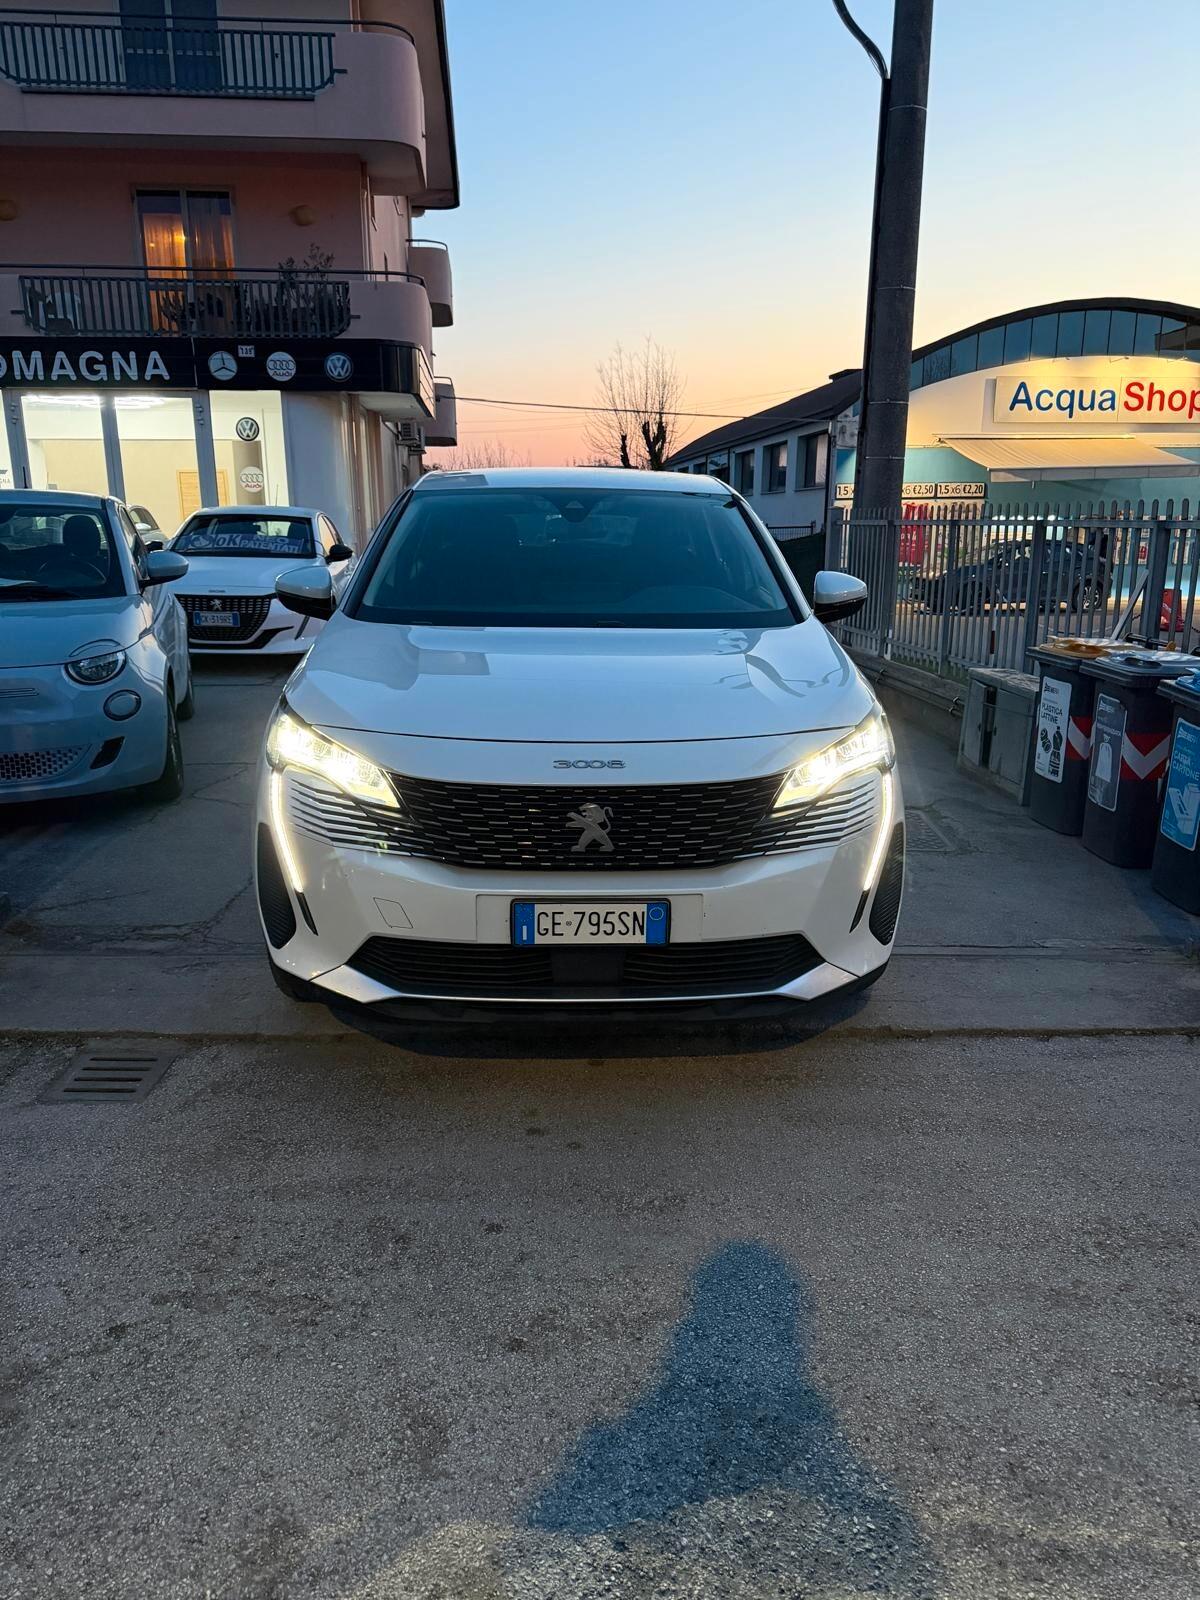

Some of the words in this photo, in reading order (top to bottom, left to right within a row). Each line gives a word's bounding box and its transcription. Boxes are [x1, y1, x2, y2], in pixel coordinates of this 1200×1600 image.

[0, 350, 171, 381] MAGNA
[1009, 381, 1117, 419] Acqua
[1123, 381, 1200, 419] Shop
[239, 540, 299, 553] PATENTATI
[553, 760, 626, 769] 3008
